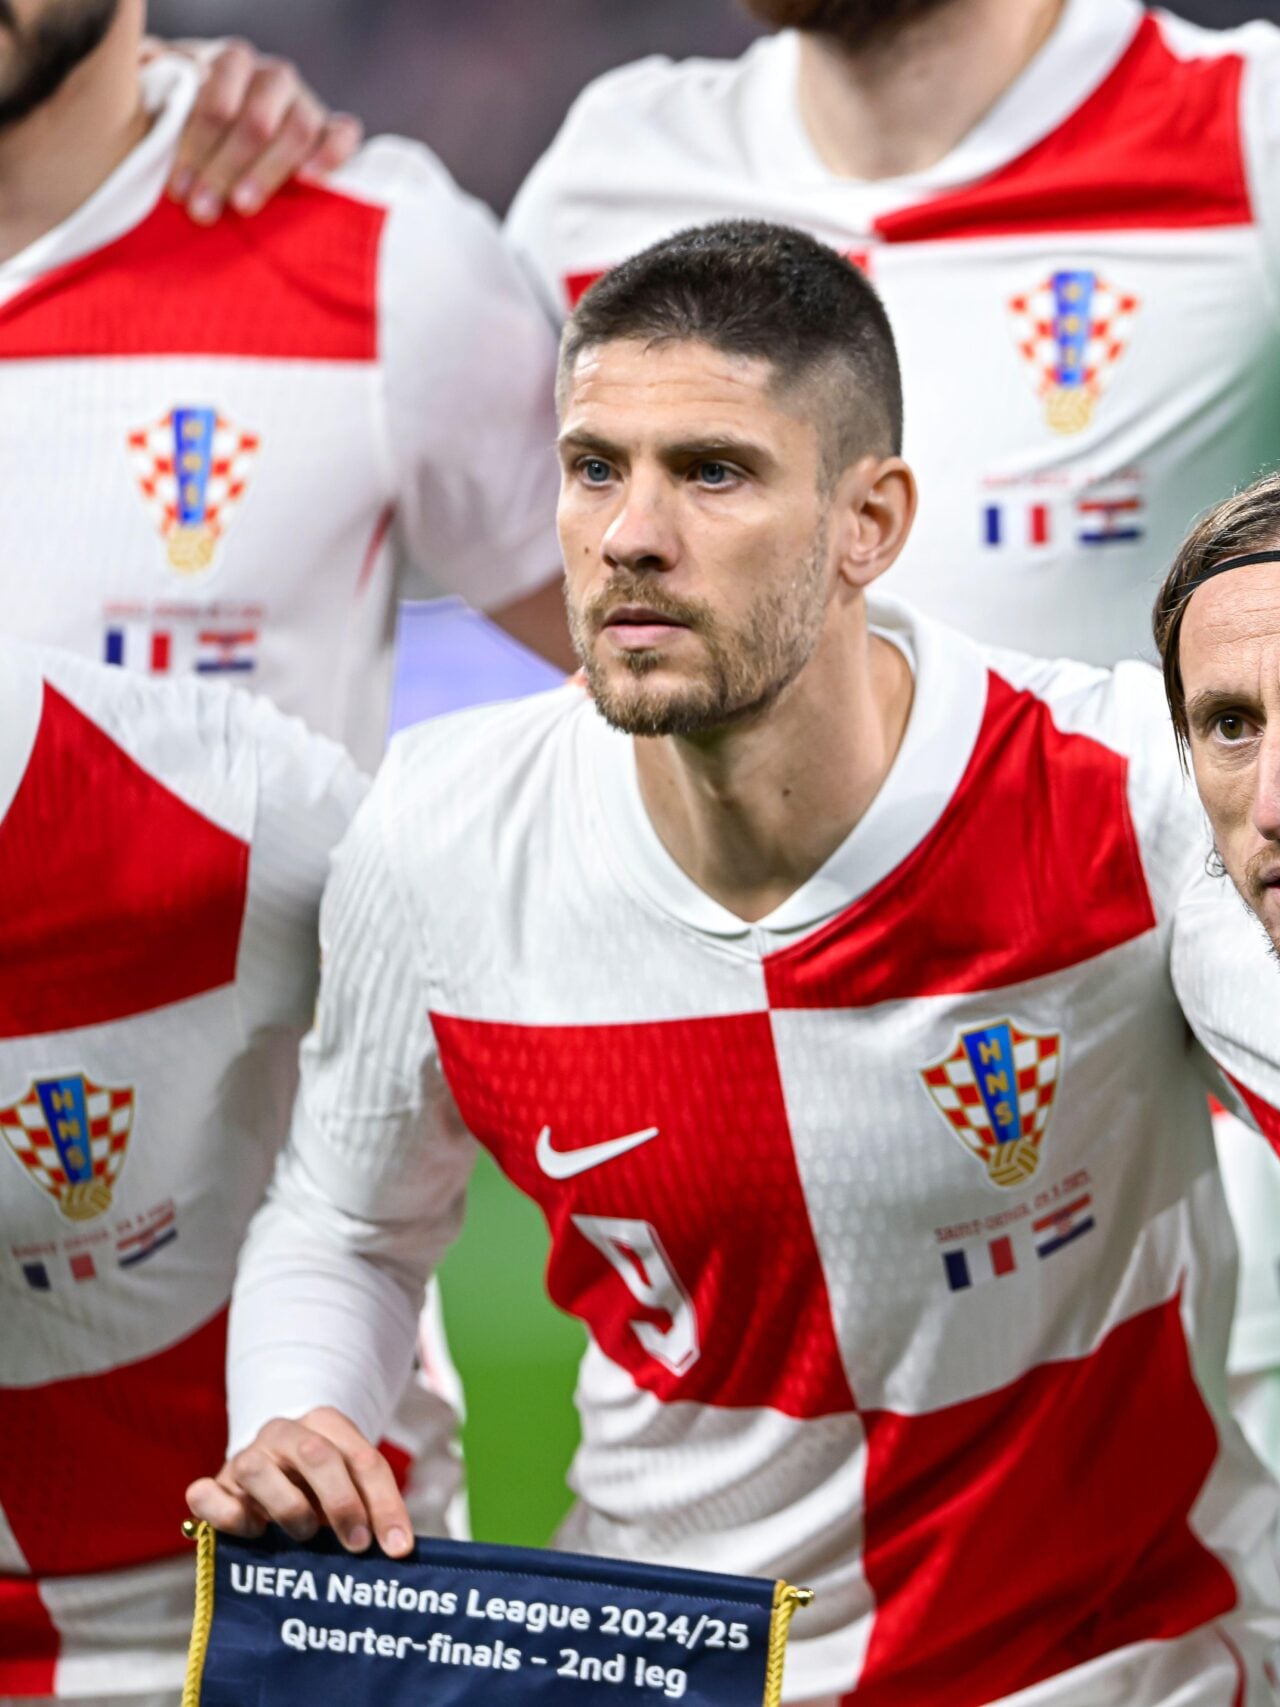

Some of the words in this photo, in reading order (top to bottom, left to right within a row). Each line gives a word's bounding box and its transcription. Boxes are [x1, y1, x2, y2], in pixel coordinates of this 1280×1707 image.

[977, 1039, 1014, 1125] HNS
[230, 1563, 318, 1601] UEFA
[326, 1573, 458, 1615] Nations
[465, 1588, 591, 1633] League
[599, 1605, 750, 1651] 2024/25
[281, 1618, 522, 1671] Quarter-finals
[556, 1648, 626, 1683] 2nd
[634, 1656, 688, 1699] leg
